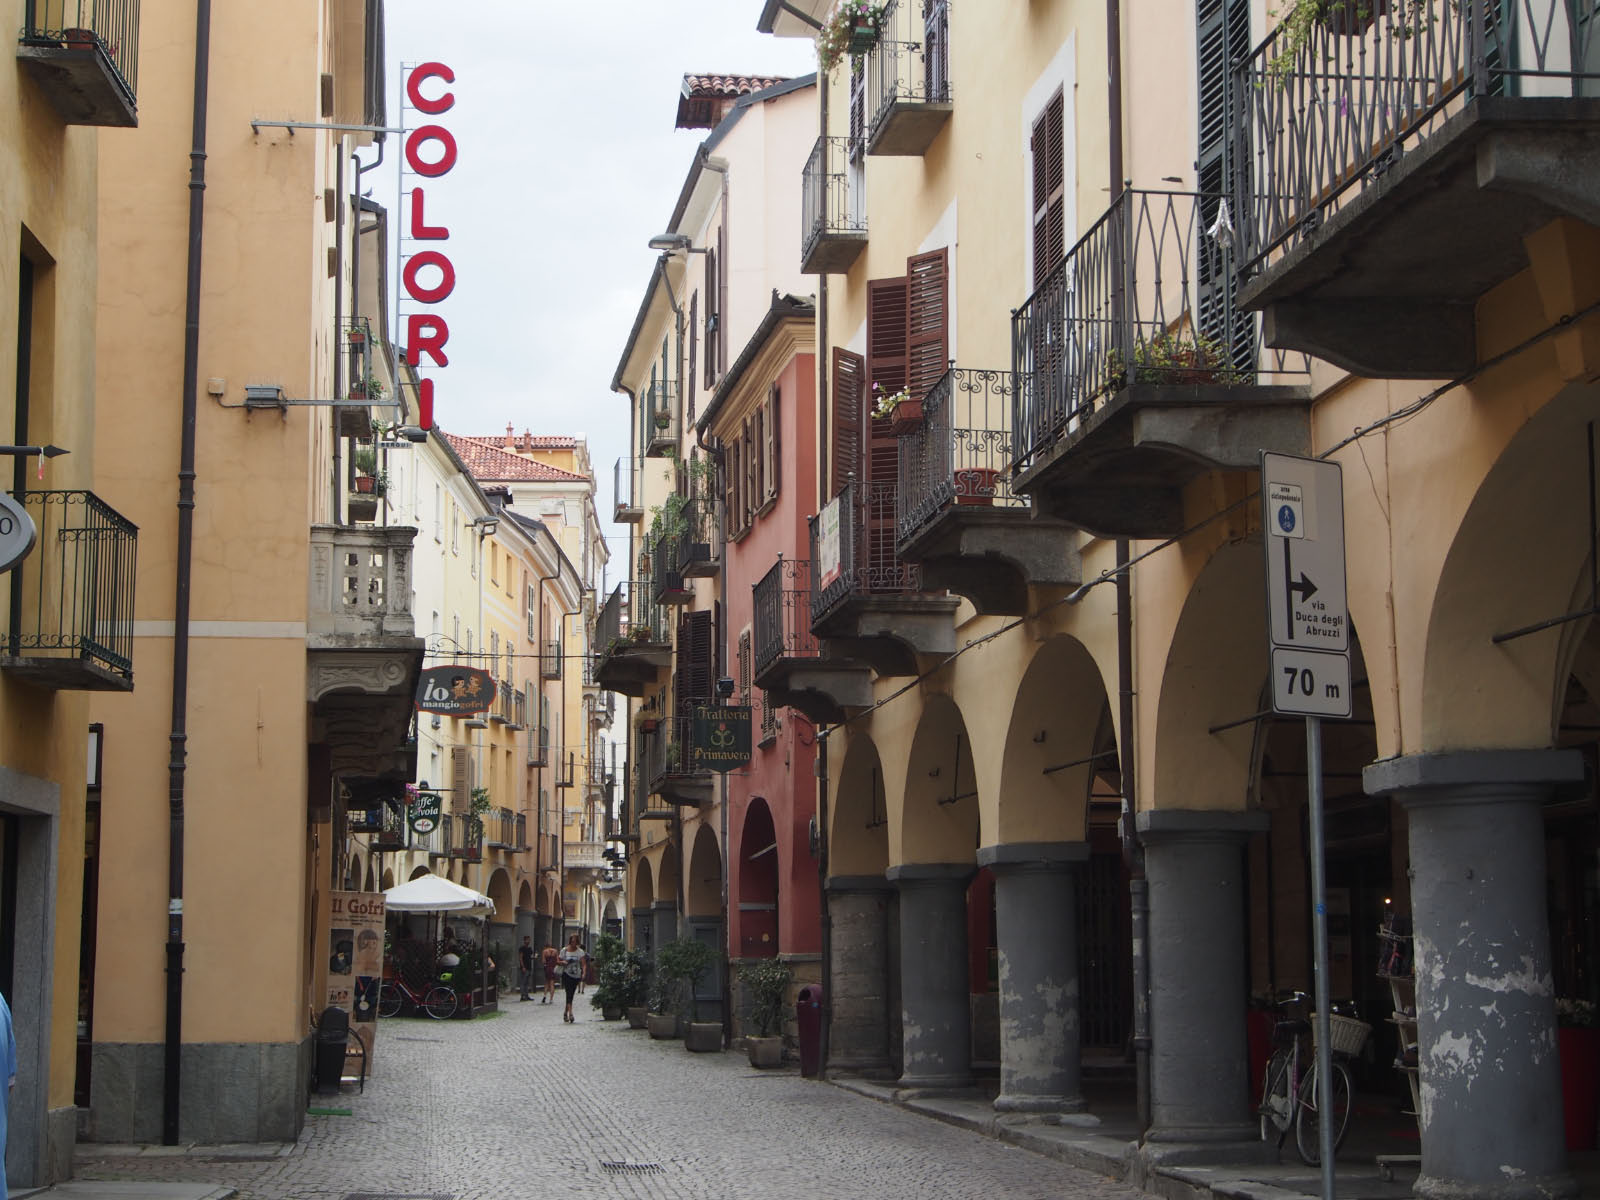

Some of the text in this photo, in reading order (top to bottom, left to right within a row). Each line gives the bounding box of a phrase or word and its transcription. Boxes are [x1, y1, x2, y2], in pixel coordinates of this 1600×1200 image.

[403, 62, 457, 431] COLORI
[1312, 601, 1326, 610] via
[1295, 611, 1343, 627] Duca degli
[1306, 625, 1340, 638] Abruzzi
[424, 678, 449, 701] io
[1284, 667, 1340, 698] 70 m
[697, 706, 749, 720] Trattoria
[694, 747, 750, 760] Primavera
[331, 898, 385, 915] Il Gofri
